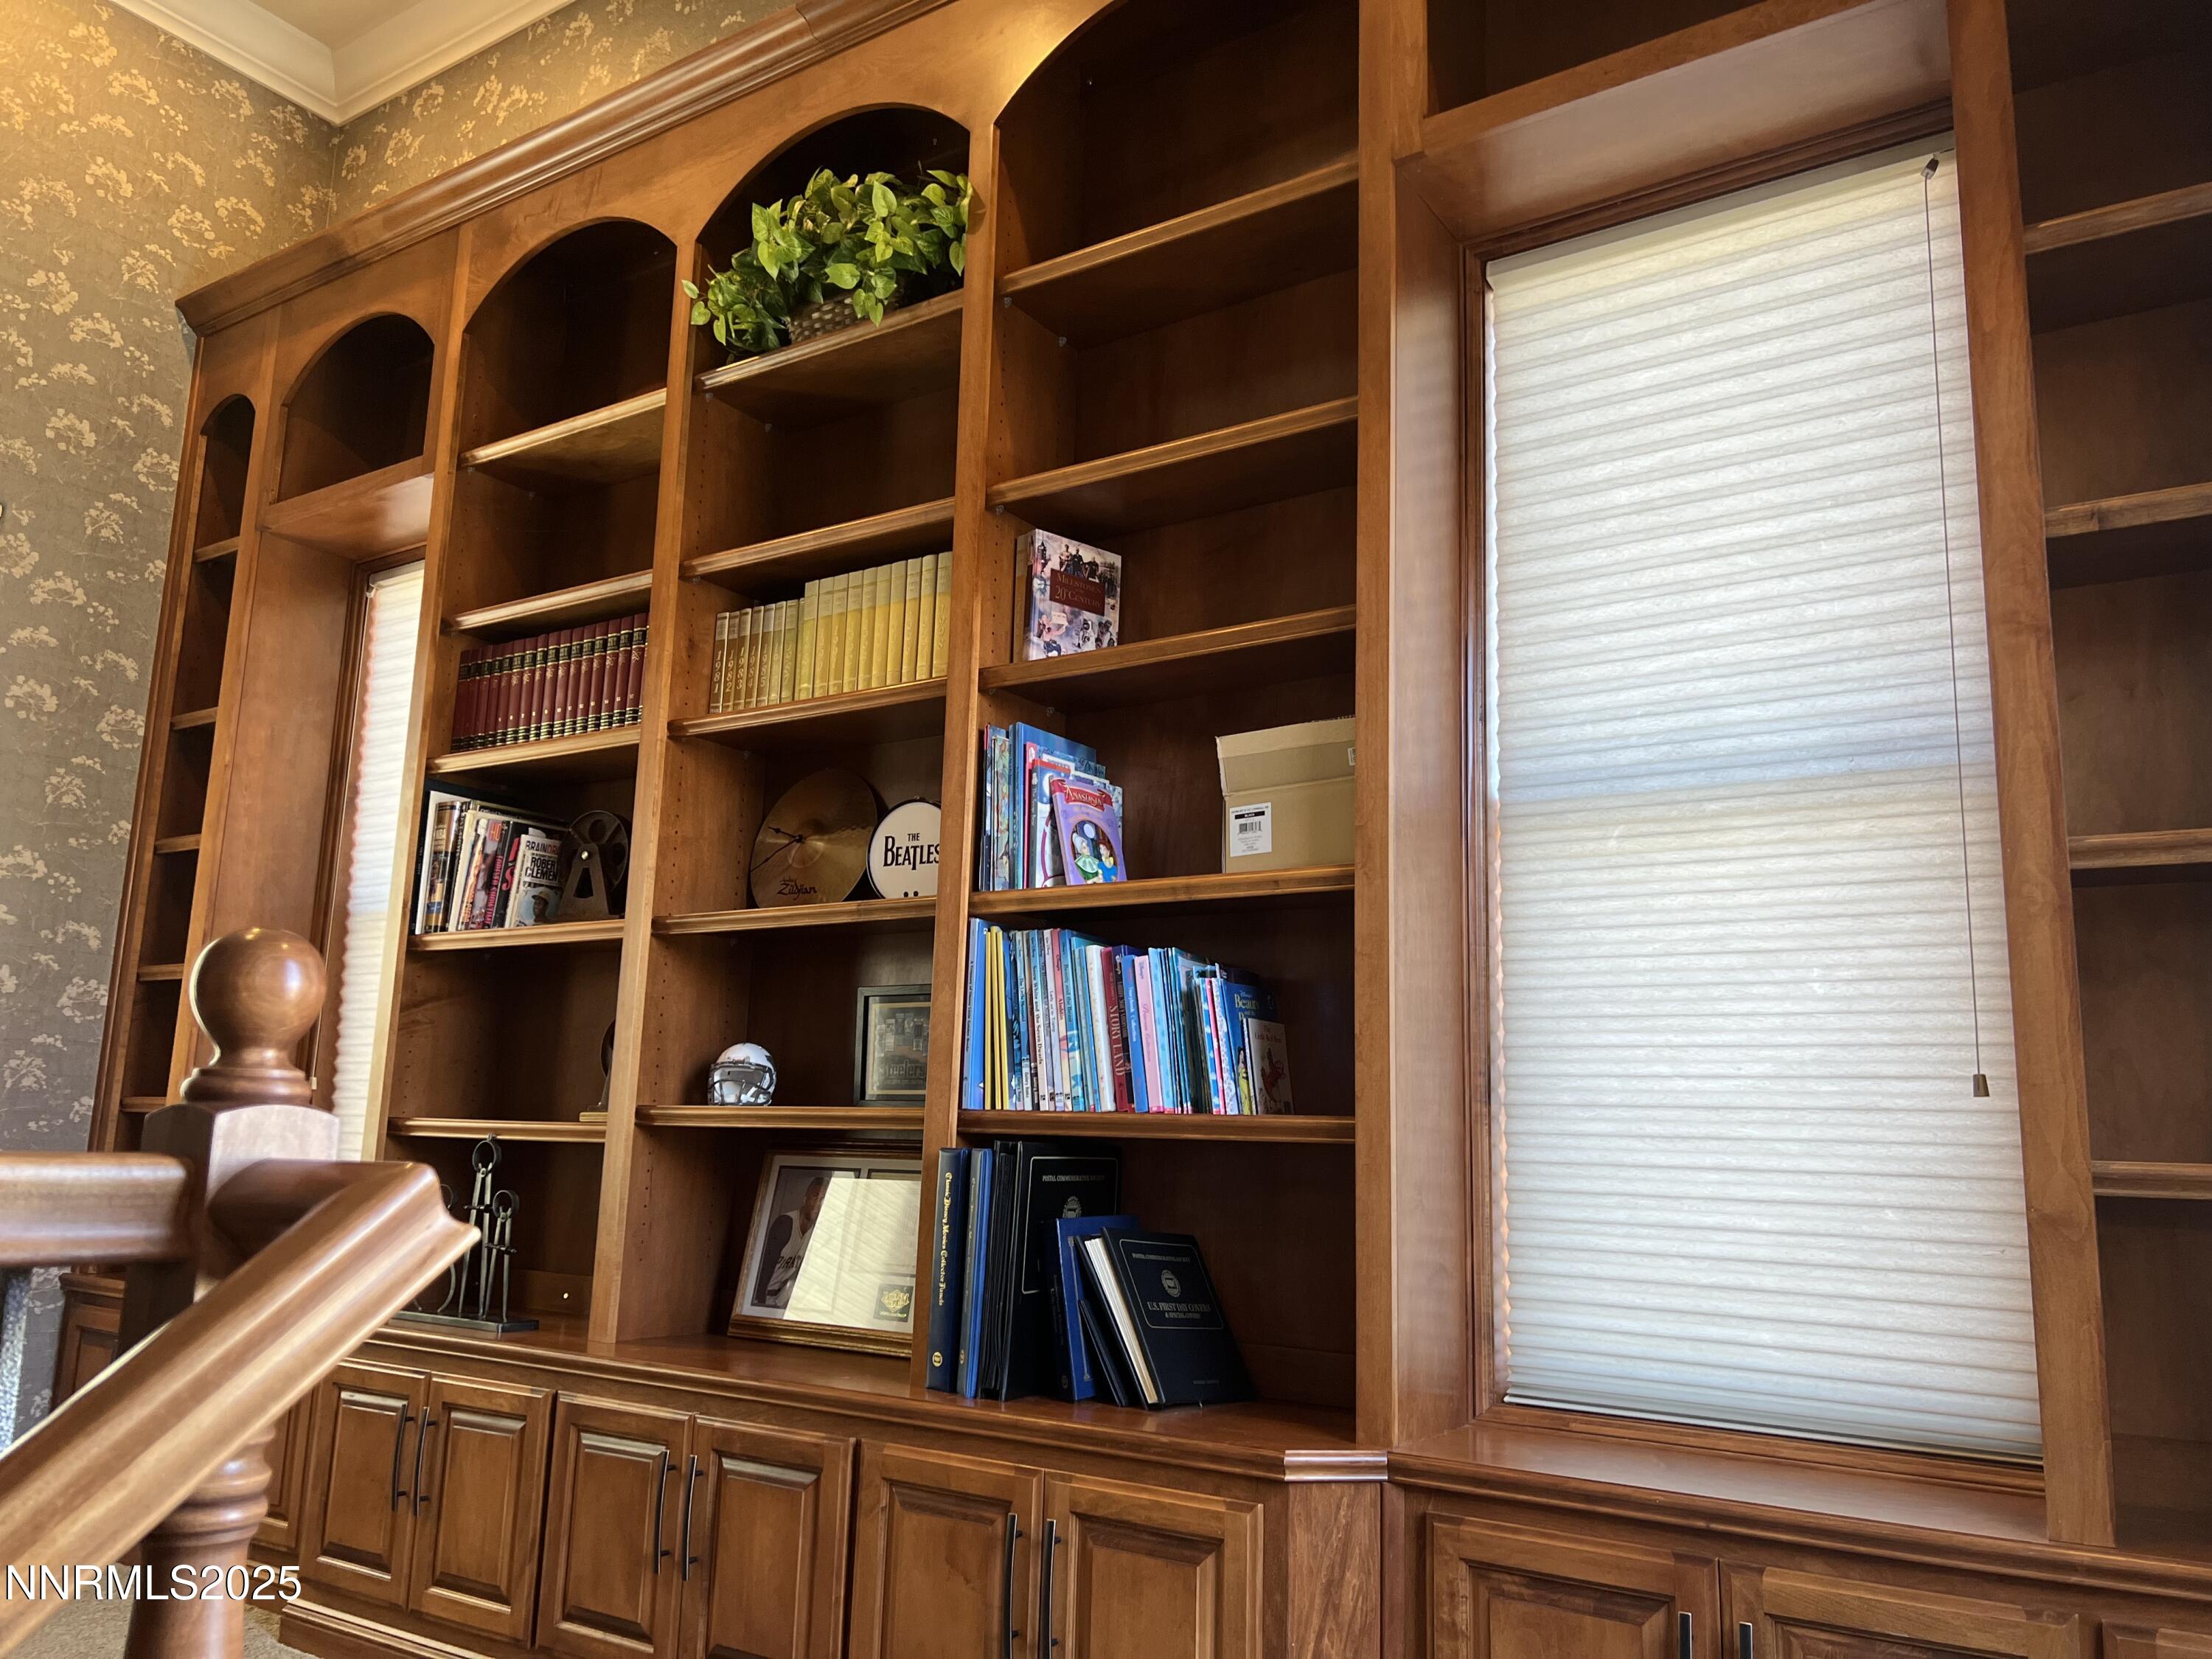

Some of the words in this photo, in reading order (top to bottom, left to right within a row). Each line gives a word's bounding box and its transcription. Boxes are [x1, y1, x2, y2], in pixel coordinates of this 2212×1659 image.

[726, 650, 734, 692] 1982
[908, 833, 920, 841] THE
[1110, 1005, 1121, 1039] STORY
[1113, 1044, 1125, 1075] LAND
[942, 1197, 951, 1223] Disney
[940, 1251, 948, 1281] Collector
[1158, 1302, 1176, 1311] FIRST
